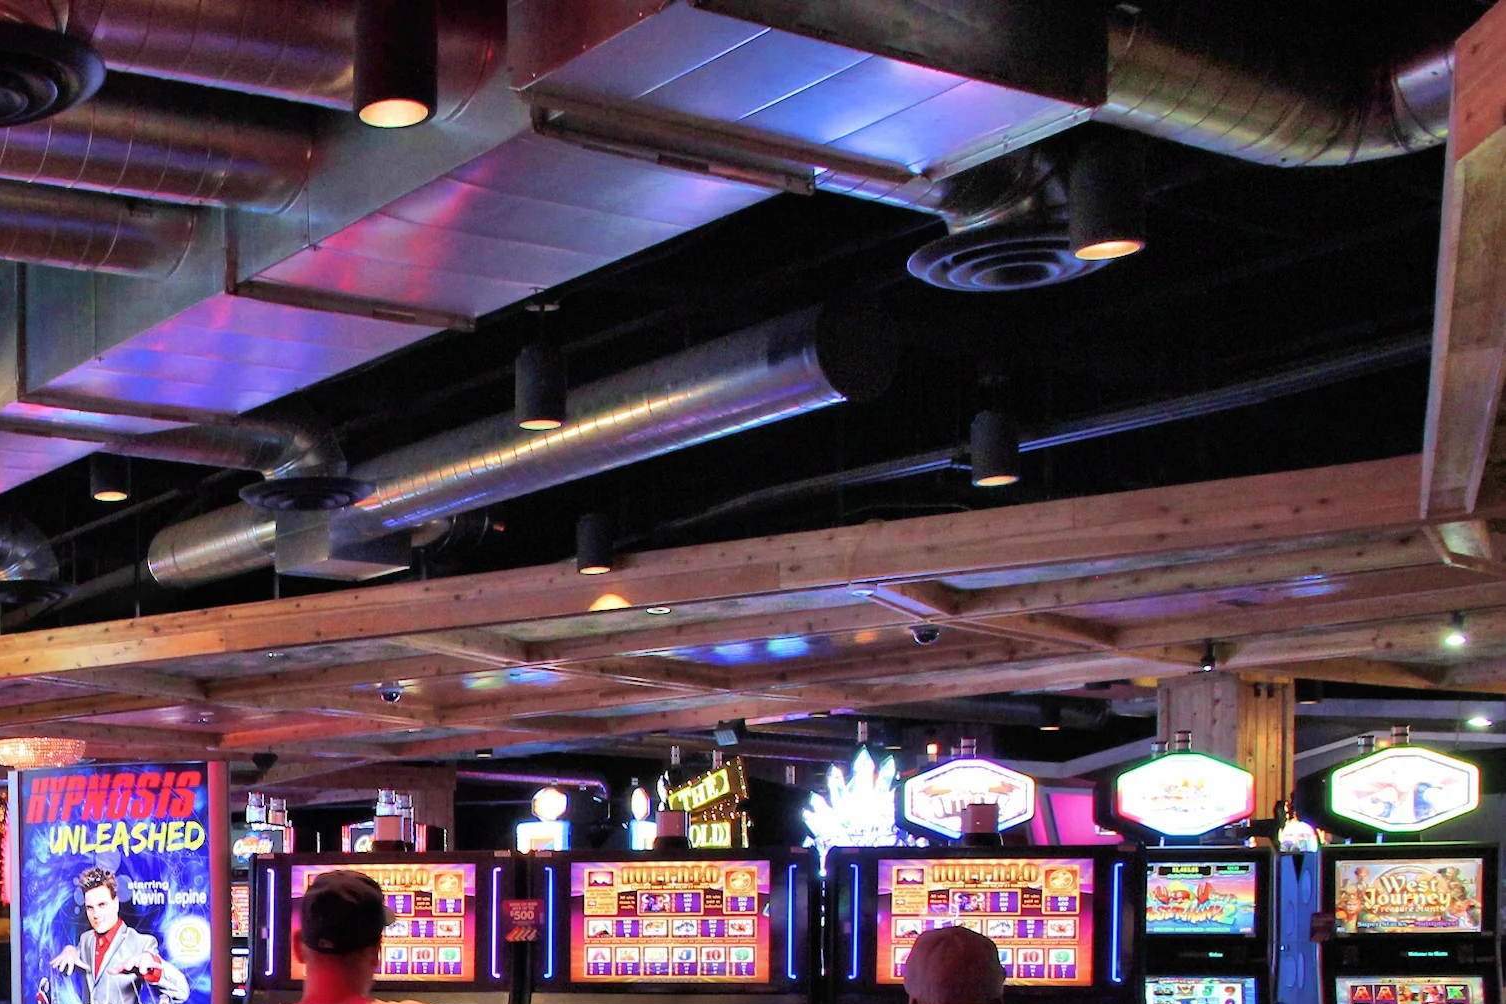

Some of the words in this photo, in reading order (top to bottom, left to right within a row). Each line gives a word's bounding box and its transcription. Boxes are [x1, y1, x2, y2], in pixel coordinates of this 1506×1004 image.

[26, 771, 201, 824] HYPNOSIS
[679, 777, 720, 812] THE
[50, 821, 205, 856] UNLEASHED
[689, 823, 724, 849] OLD
[257, 839, 273, 854] Hit
[127, 880, 169, 890] starring
[1380, 875, 1439, 893] West
[132, 890, 164, 905] Kevin
[169, 890, 207, 907] Lepine
[1364, 888, 1451, 911] Journey
[510, 911, 534, 920] $500
[1373, 904, 1414, 913] Treasure
[1415, 904, 1443, 912] Hunt
[705, 949, 722, 961] 10
[1022, 951, 1040, 962] 10
[1353, 986, 1371, 1000] A
[1376, 986, 1394, 1000] A
[1446, 986, 1465, 1000] K
